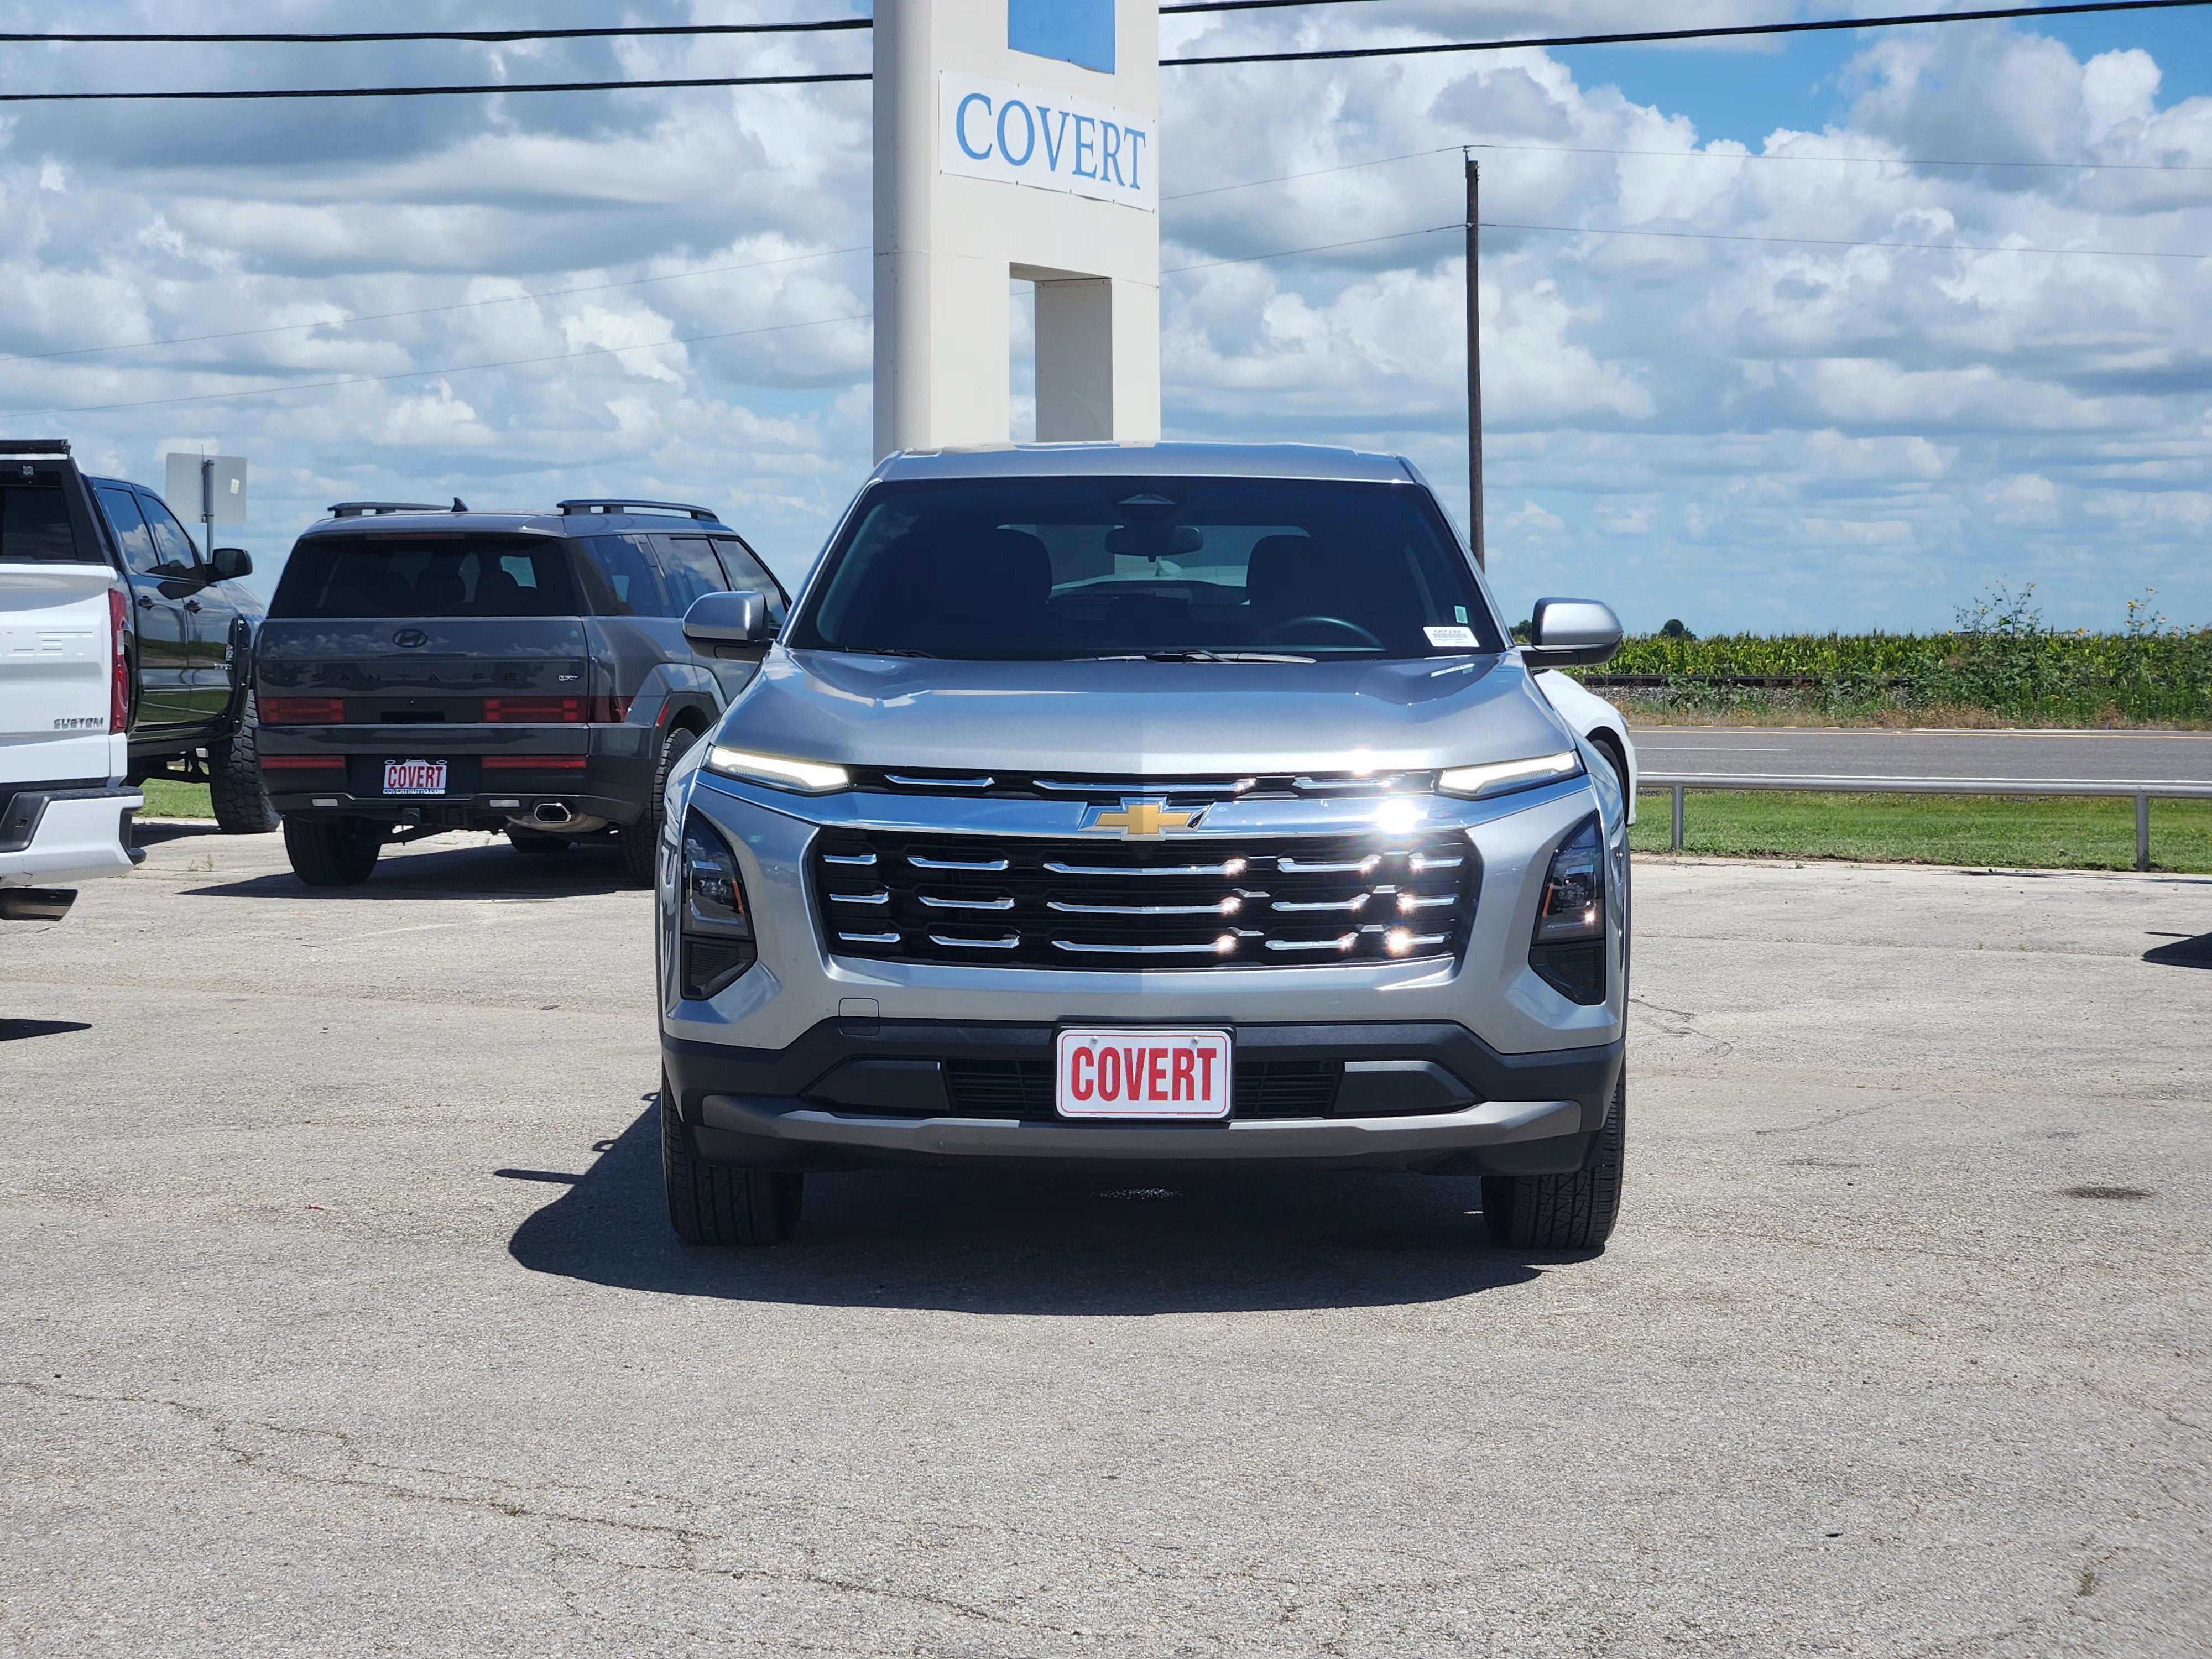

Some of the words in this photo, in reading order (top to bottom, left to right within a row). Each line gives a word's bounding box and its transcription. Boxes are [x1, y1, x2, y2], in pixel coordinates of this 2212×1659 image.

[956, 93, 1146, 190] COVERT
[311, 672, 442, 682] SANTA
[472, 672, 518, 681] FE
[54, 717, 104, 729] CUSTOM
[388, 766, 444, 787] COVERT
[1071, 1046, 1217, 1101] COVERT
